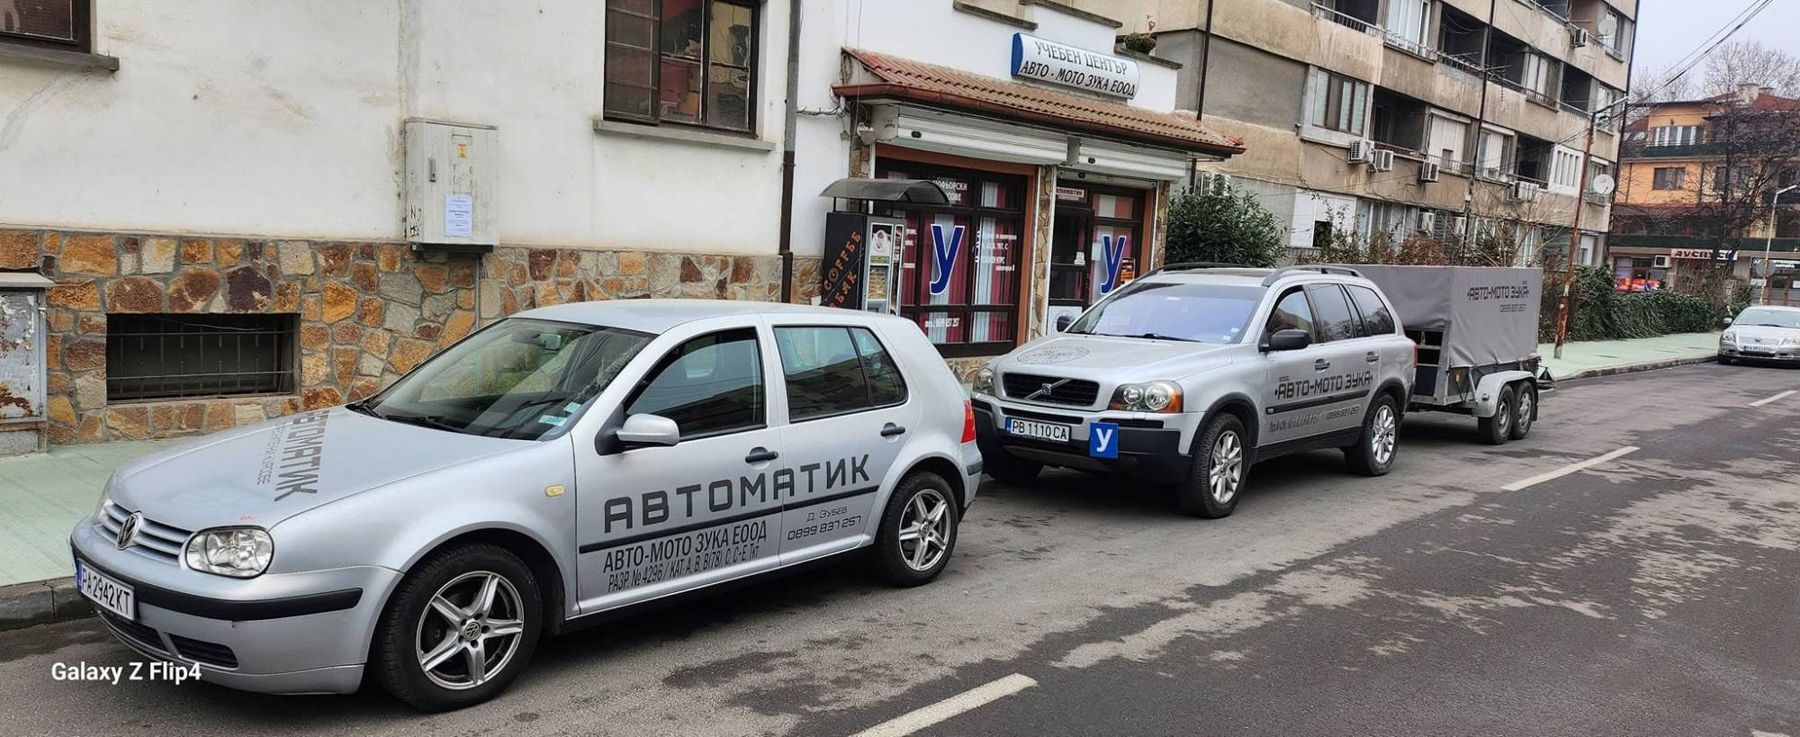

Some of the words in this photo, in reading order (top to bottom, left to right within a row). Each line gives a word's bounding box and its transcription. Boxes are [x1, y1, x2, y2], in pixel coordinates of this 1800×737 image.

[1034, 41, 1082, 65] УЧЕБЕН
[1084, 53, 1128, 75] ЦЕНТЪР
[1020, 60, 1049, 78] АВТО
[1056, 68, 1085, 87] МОТО
[1085, 74, 1109, 93] ЗУКА
[1110, 80, 1136, 97] ЕООД
[823, 231, 861, 291] COFFEE
[1278, 375, 1343, 400] АВТО-МОТО
[1345, 370, 1370, 389] ЗУКА
[604, 454, 870, 534] АВТОМАТИК
[787, 526, 817, 540] 0899
[819, 519, 840, 533] 837
[841, 515, 862, 528] 257
[603, 536, 692, 574] АВТО-МОТО
[695, 528, 729, 553] ЗУКА
[732, 520, 767, 545] ЕООД
[643, 563, 663, 583] 4296
